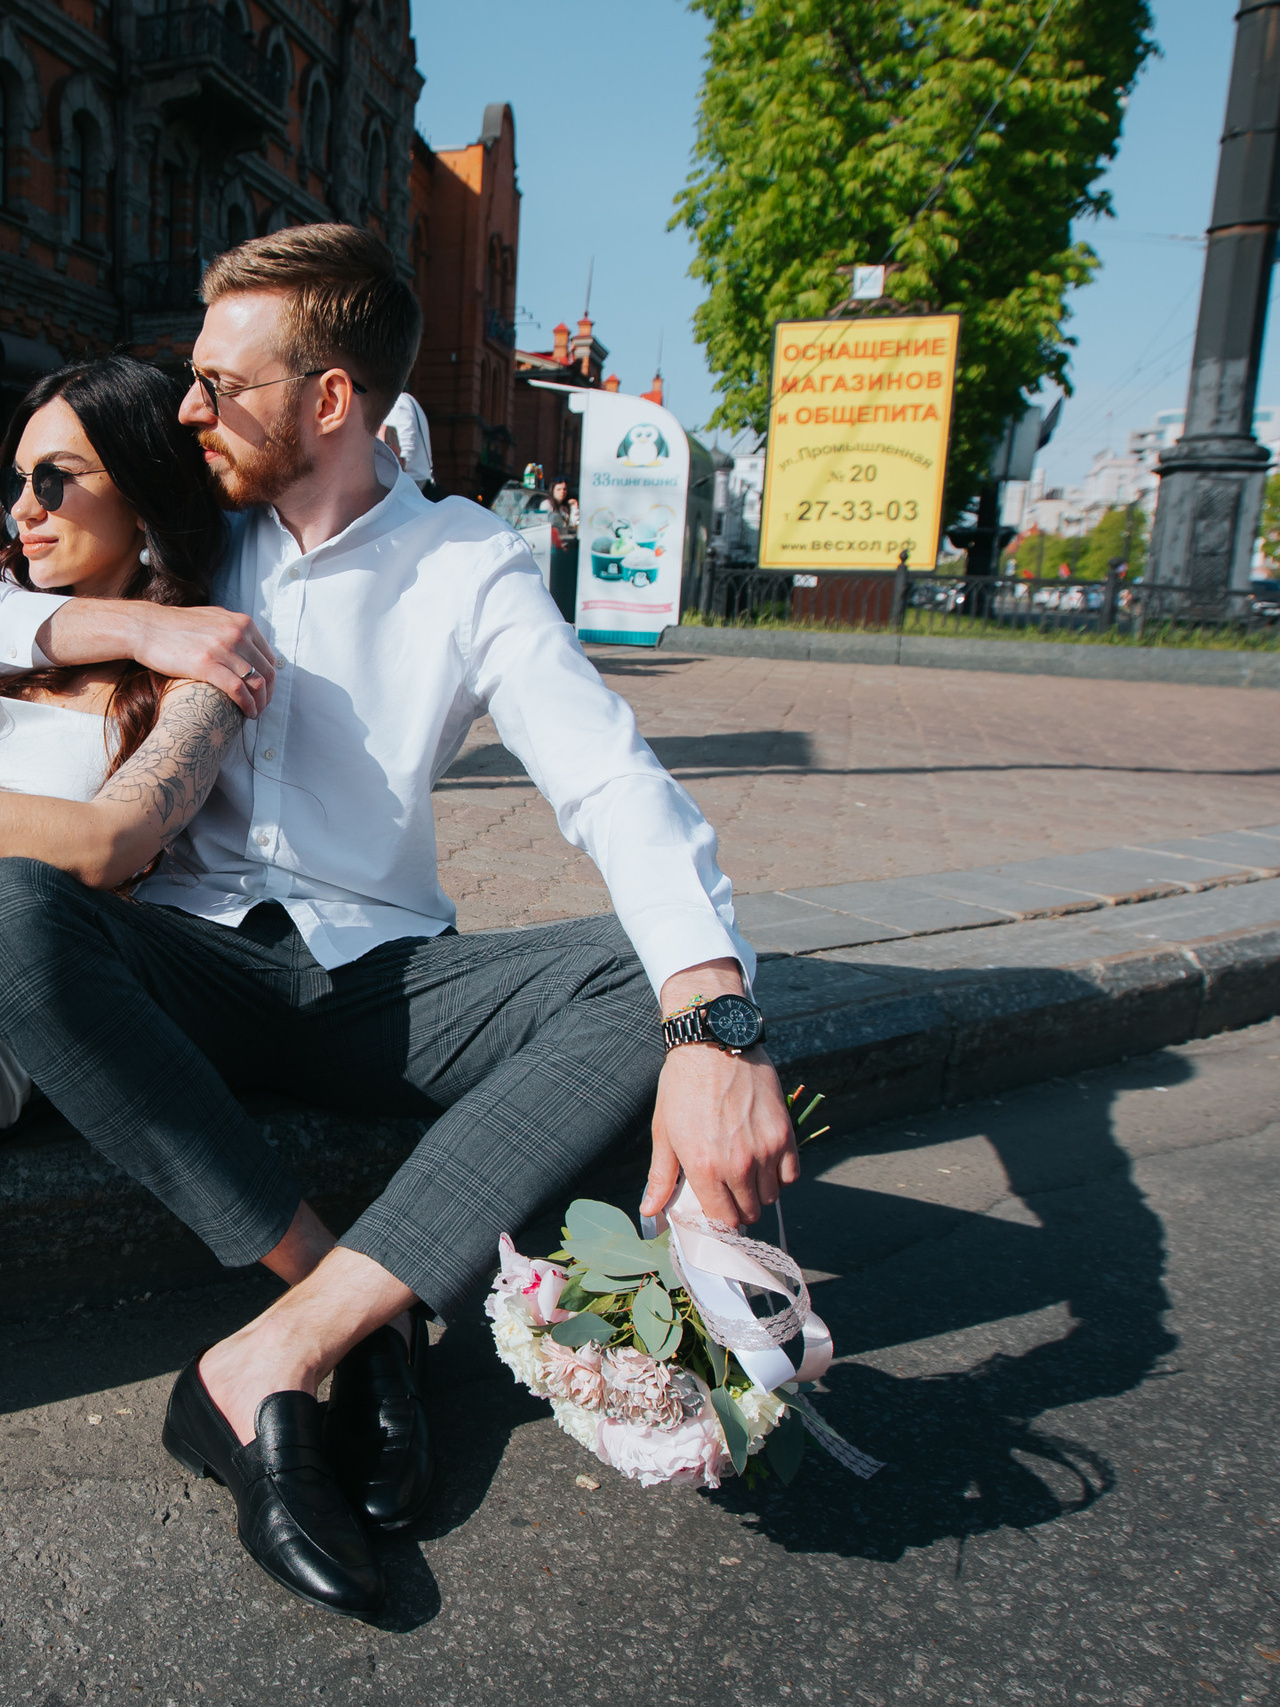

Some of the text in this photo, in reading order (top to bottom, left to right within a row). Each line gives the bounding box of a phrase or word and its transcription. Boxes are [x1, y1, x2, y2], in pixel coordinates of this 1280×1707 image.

[783, 337, 947, 362] ОСНАЩЕНИЕ
[780, 371, 943, 393] МАГАЗИНОВ
[795, 404, 940, 426] ОБЩЕПИТА
[798, 442, 934, 469] Промышленная
[850, 464, 877, 482] 20
[798, 500, 919, 522] 27-33-03
